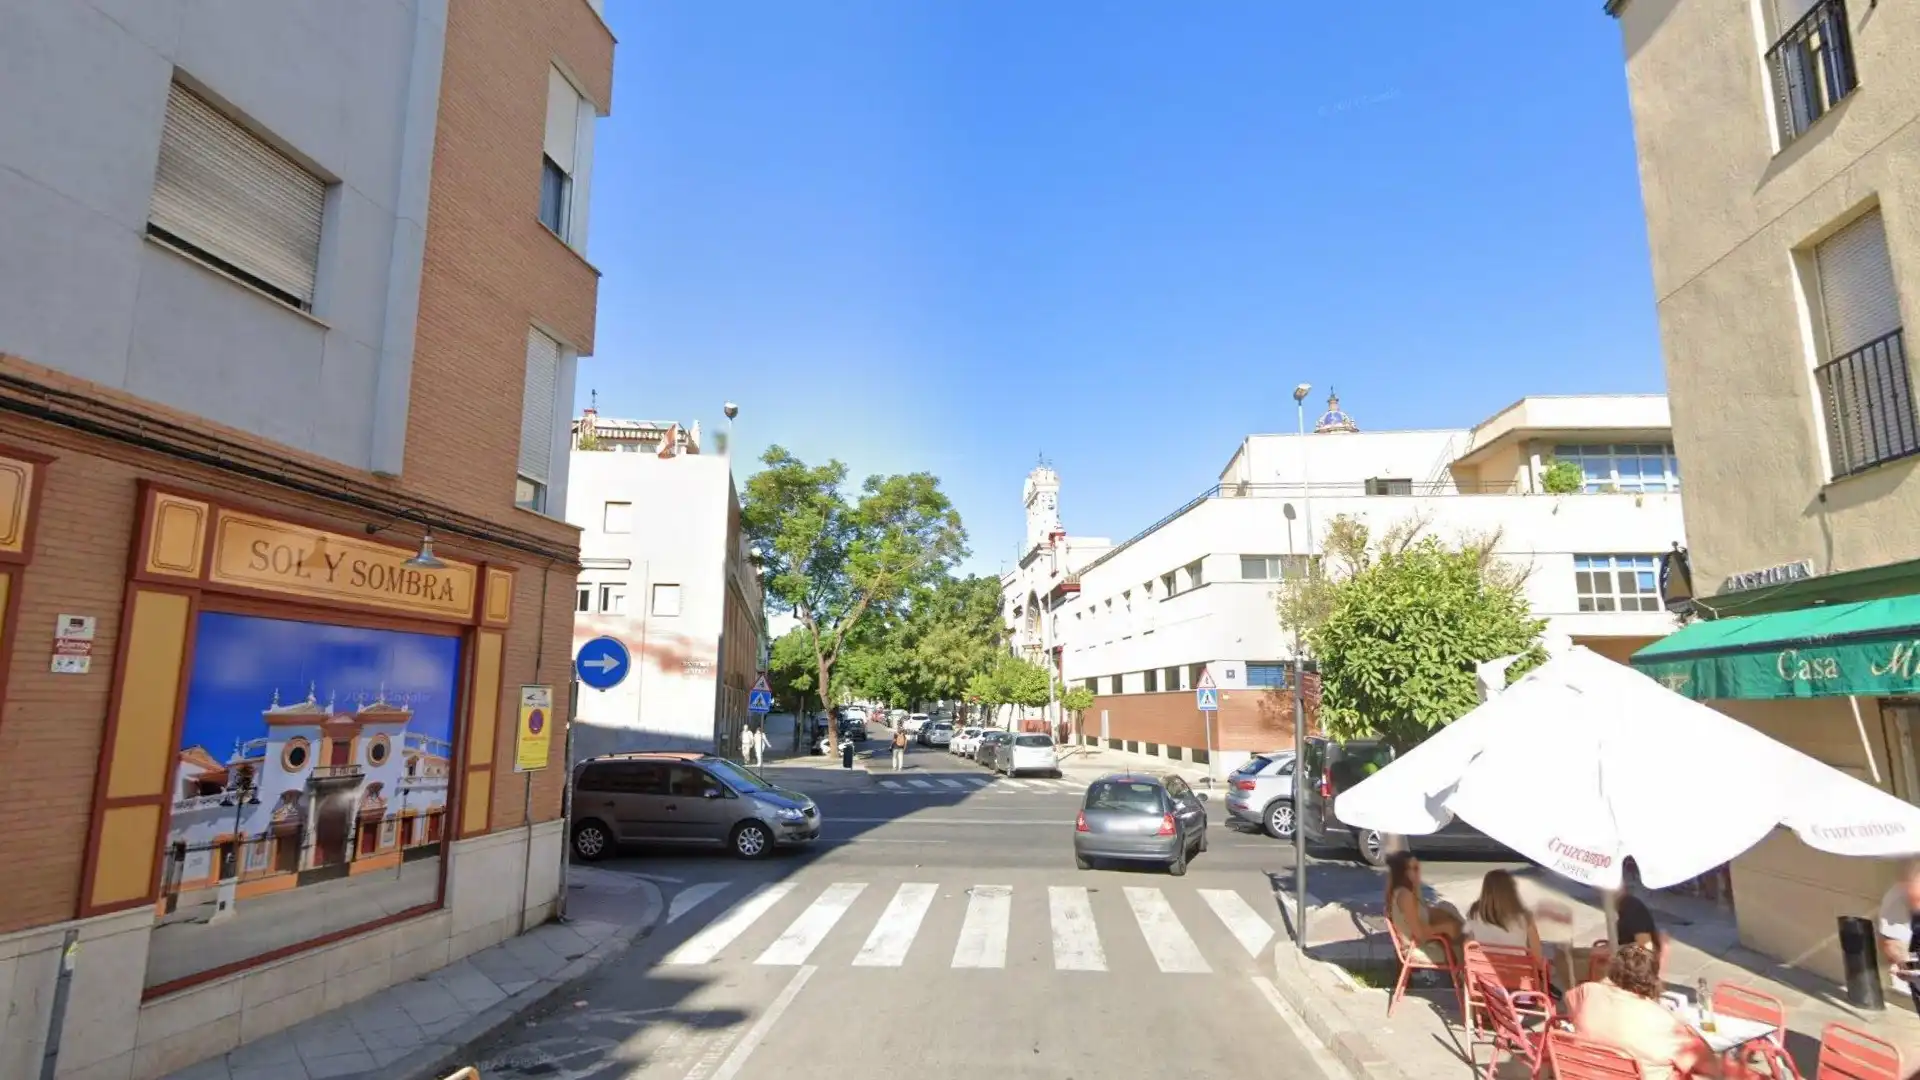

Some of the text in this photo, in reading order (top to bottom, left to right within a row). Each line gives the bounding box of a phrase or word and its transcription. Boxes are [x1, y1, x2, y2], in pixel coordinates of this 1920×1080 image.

[248, 539, 454, 602] SOL Y SOMBRA
[1777, 649, 1839, 681] Casa
[1548, 836, 1613, 869] Cruzcampo
